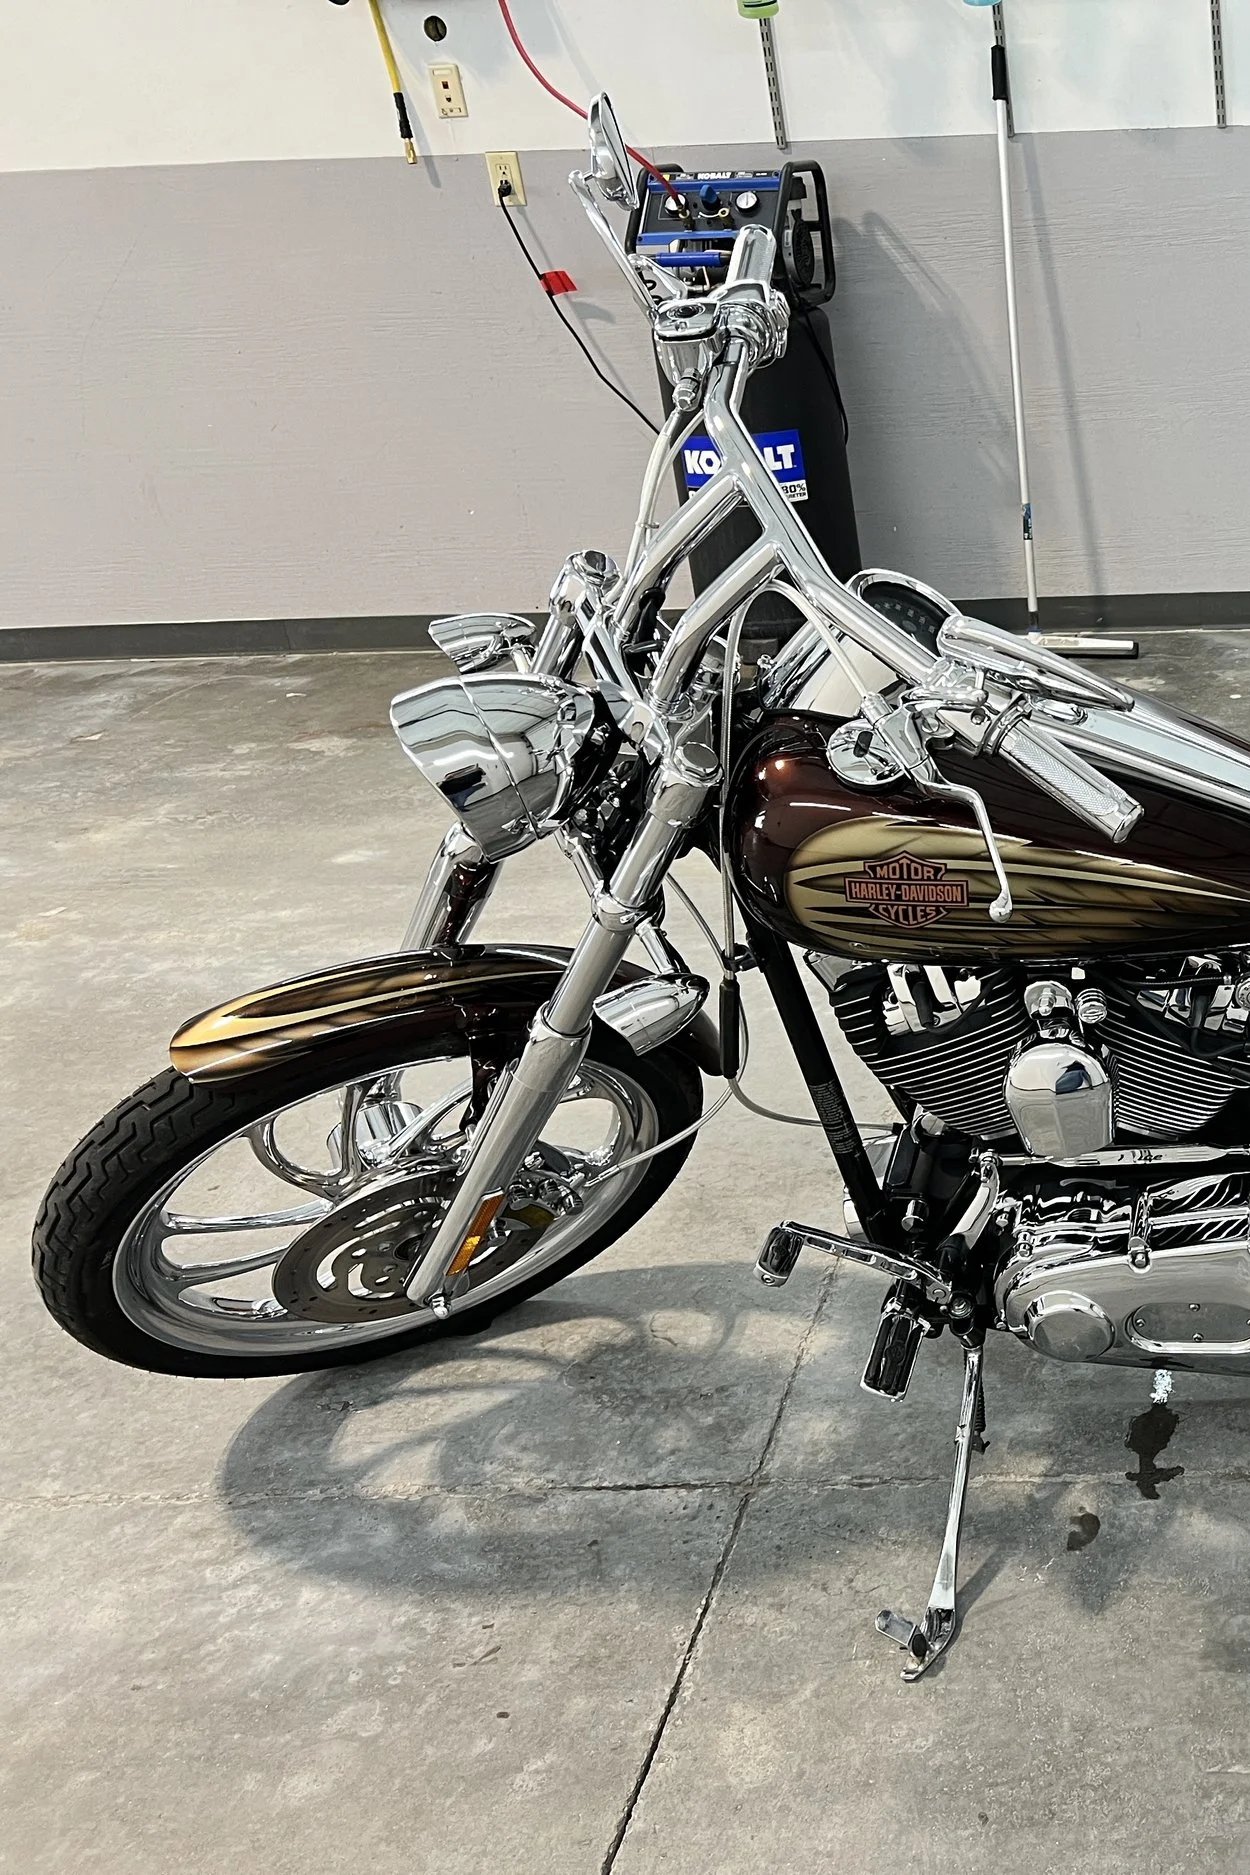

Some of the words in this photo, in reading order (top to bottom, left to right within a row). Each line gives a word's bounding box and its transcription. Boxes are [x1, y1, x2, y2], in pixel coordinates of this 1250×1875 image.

[697, 171, 732, 180] KOBALT
[684, 444, 795, 475] KOLT
[876, 858, 935, 880] MOTOR
[851, 882, 962, 902] HARLEY-DAVIDSON
[878, 906, 937, 925] CYCLES
